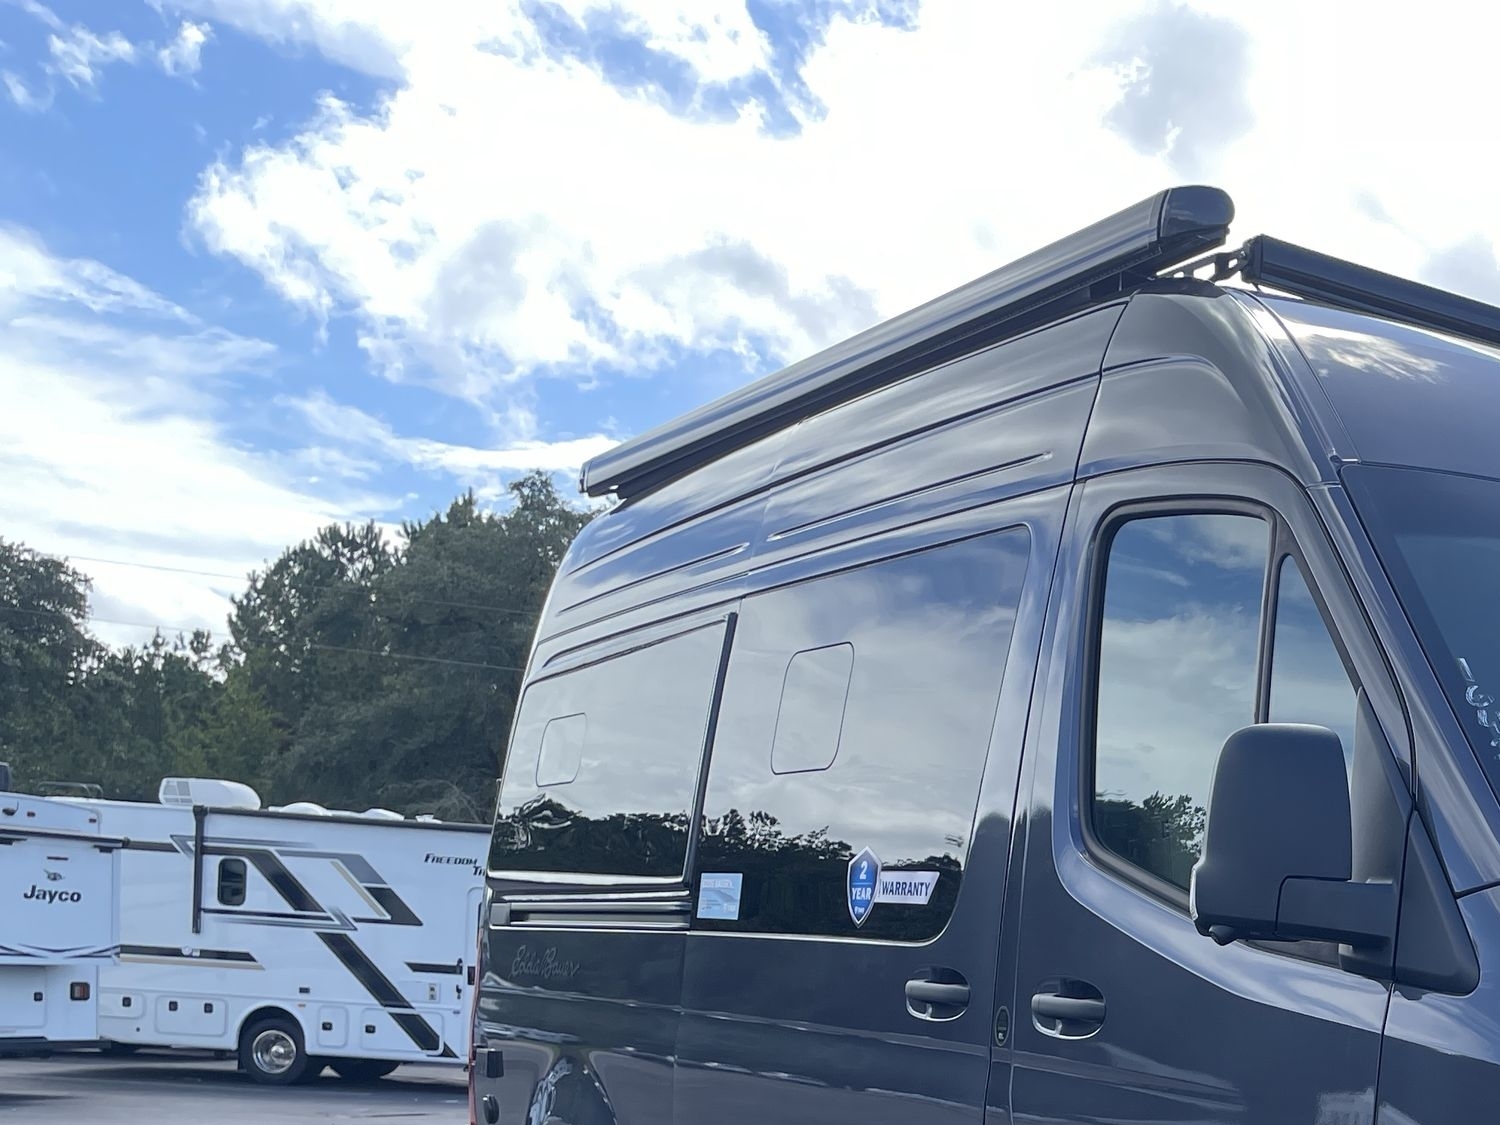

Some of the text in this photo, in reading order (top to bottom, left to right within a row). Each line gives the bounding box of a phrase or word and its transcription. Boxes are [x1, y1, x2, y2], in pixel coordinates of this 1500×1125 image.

[859, 861, 868, 880] 2
[23, 885, 82, 904] Jayco
[851, 887, 872, 901] YEAR
[882, 880, 931, 897] WARRANTY
